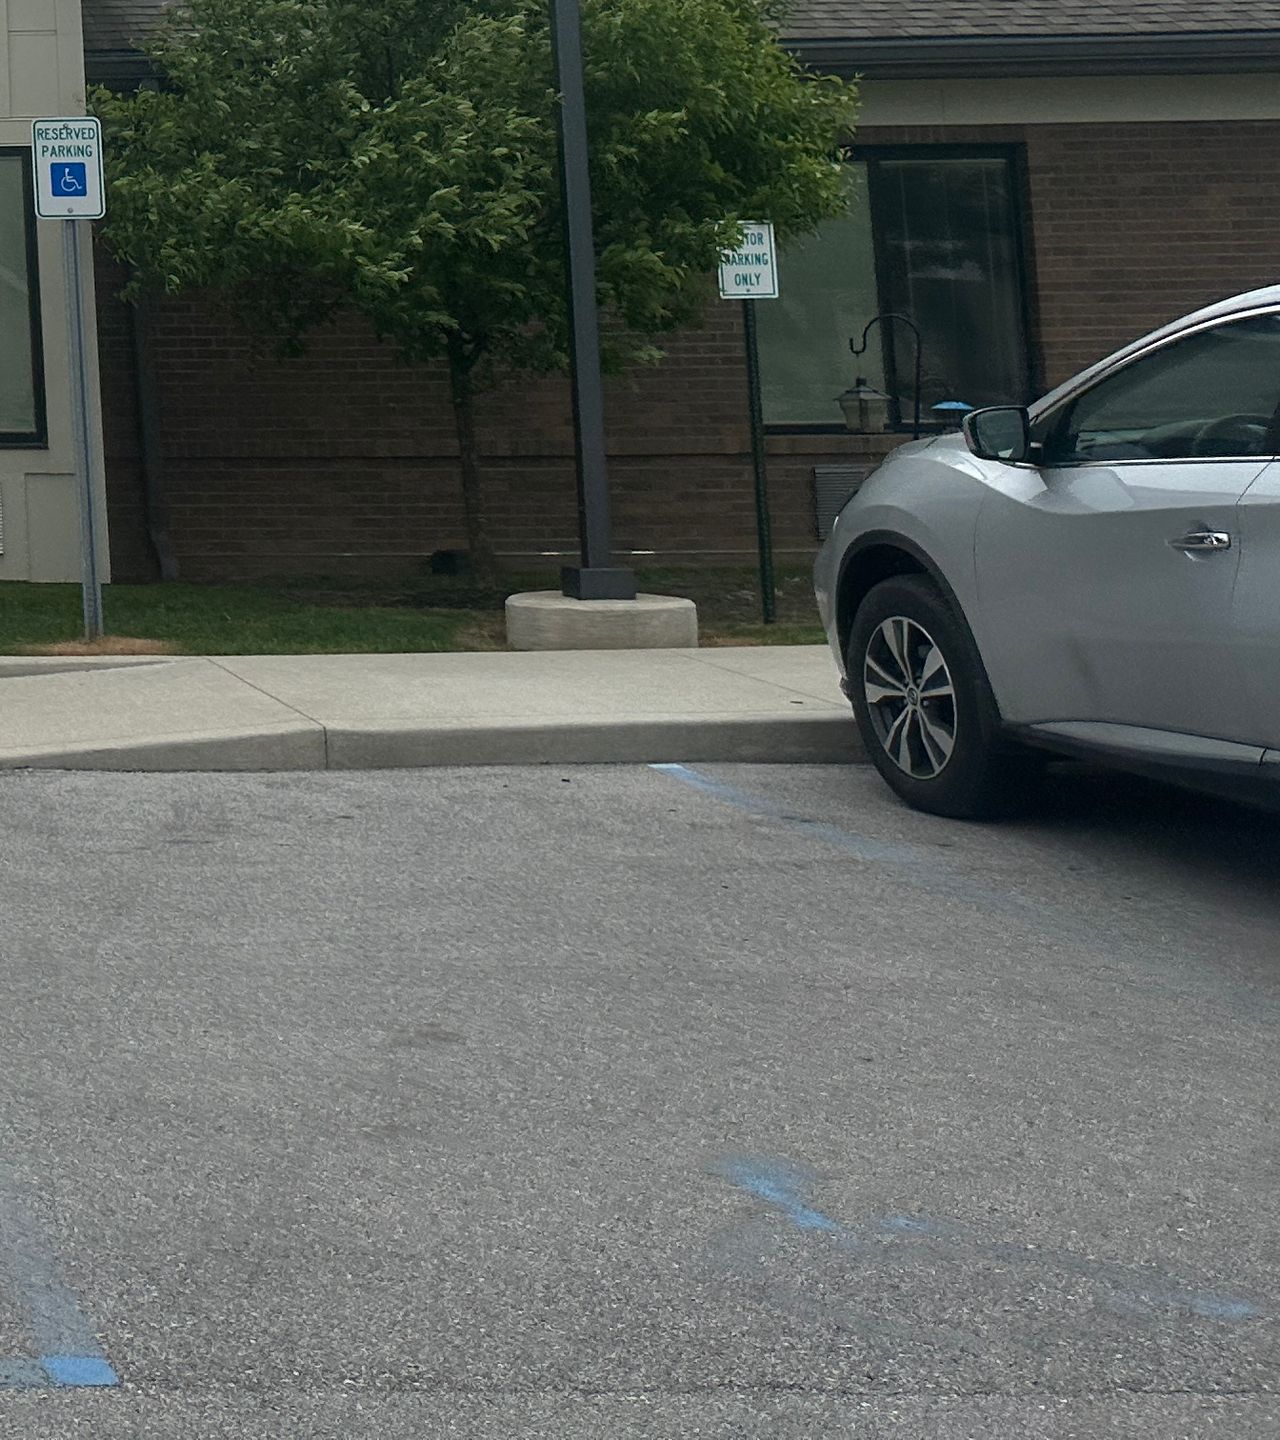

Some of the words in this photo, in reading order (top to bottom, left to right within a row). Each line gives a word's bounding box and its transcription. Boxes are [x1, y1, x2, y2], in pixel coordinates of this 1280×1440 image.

[37, 127, 95, 140] RESERVED
[41, 145, 93, 157] PARKING
[726, 253, 769, 266] ARKING
[734, 273, 762, 286] ONLY
